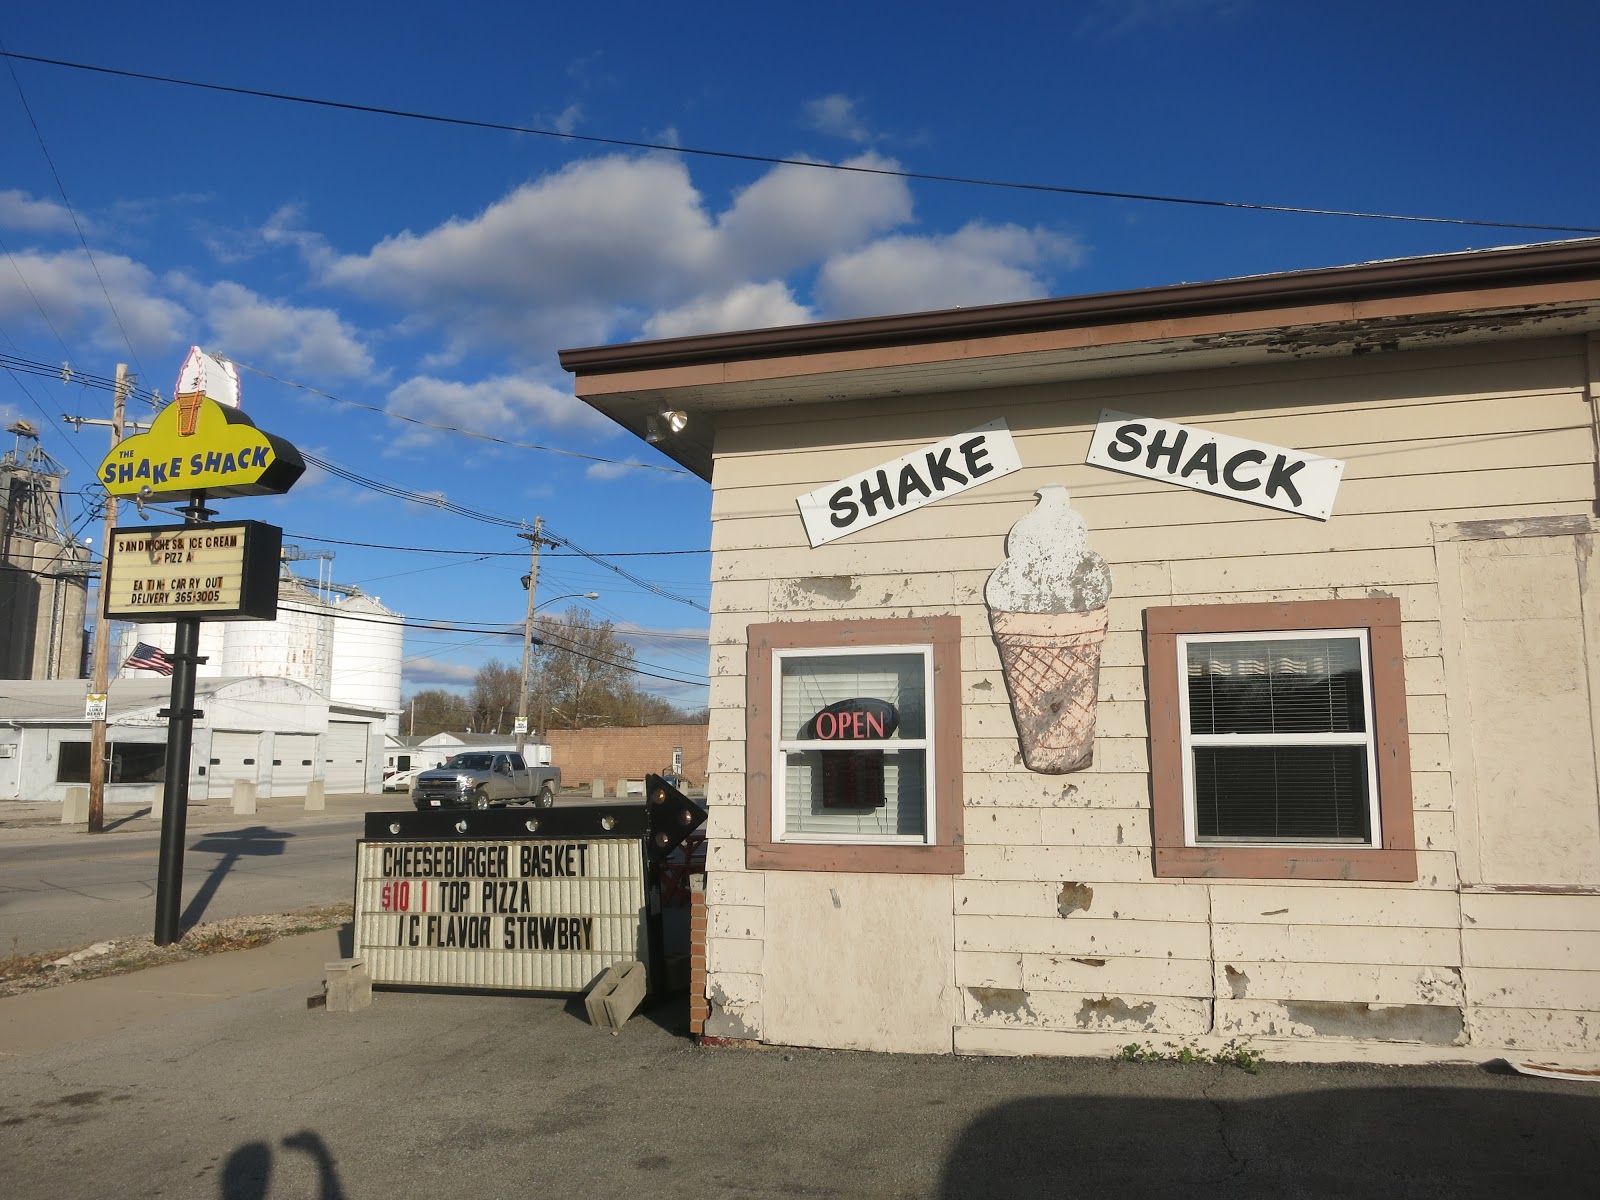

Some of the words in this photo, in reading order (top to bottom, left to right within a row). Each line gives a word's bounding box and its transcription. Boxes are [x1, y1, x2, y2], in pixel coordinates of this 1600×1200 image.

[103, 457, 182, 485] SHAKE
[190, 446, 270, 475] SHACK
[119, 450, 134, 458] THE
[1106, 422, 1307, 508] SHACK
[829, 435, 995, 529] SHAKE
[189, 537, 202, 549] ICE
[205, 535, 237, 548] CREAM
[131, 592, 170, 604] DELIVERY
[171, 577, 200, 590] CARRY
[205, 576, 223, 589] OUT
[816, 711, 885, 740] OPEN
[383, 846, 509, 877] CHEESEBURGER
[520, 844, 588, 877] BASKET
[382, 881, 410, 912] $10
[439, 881, 470, 913] TOP
[482, 882, 531, 913] PIZZA
[427, 916, 491, 948] FLAVOR
[504, 917, 593, 951] STRWBRY
